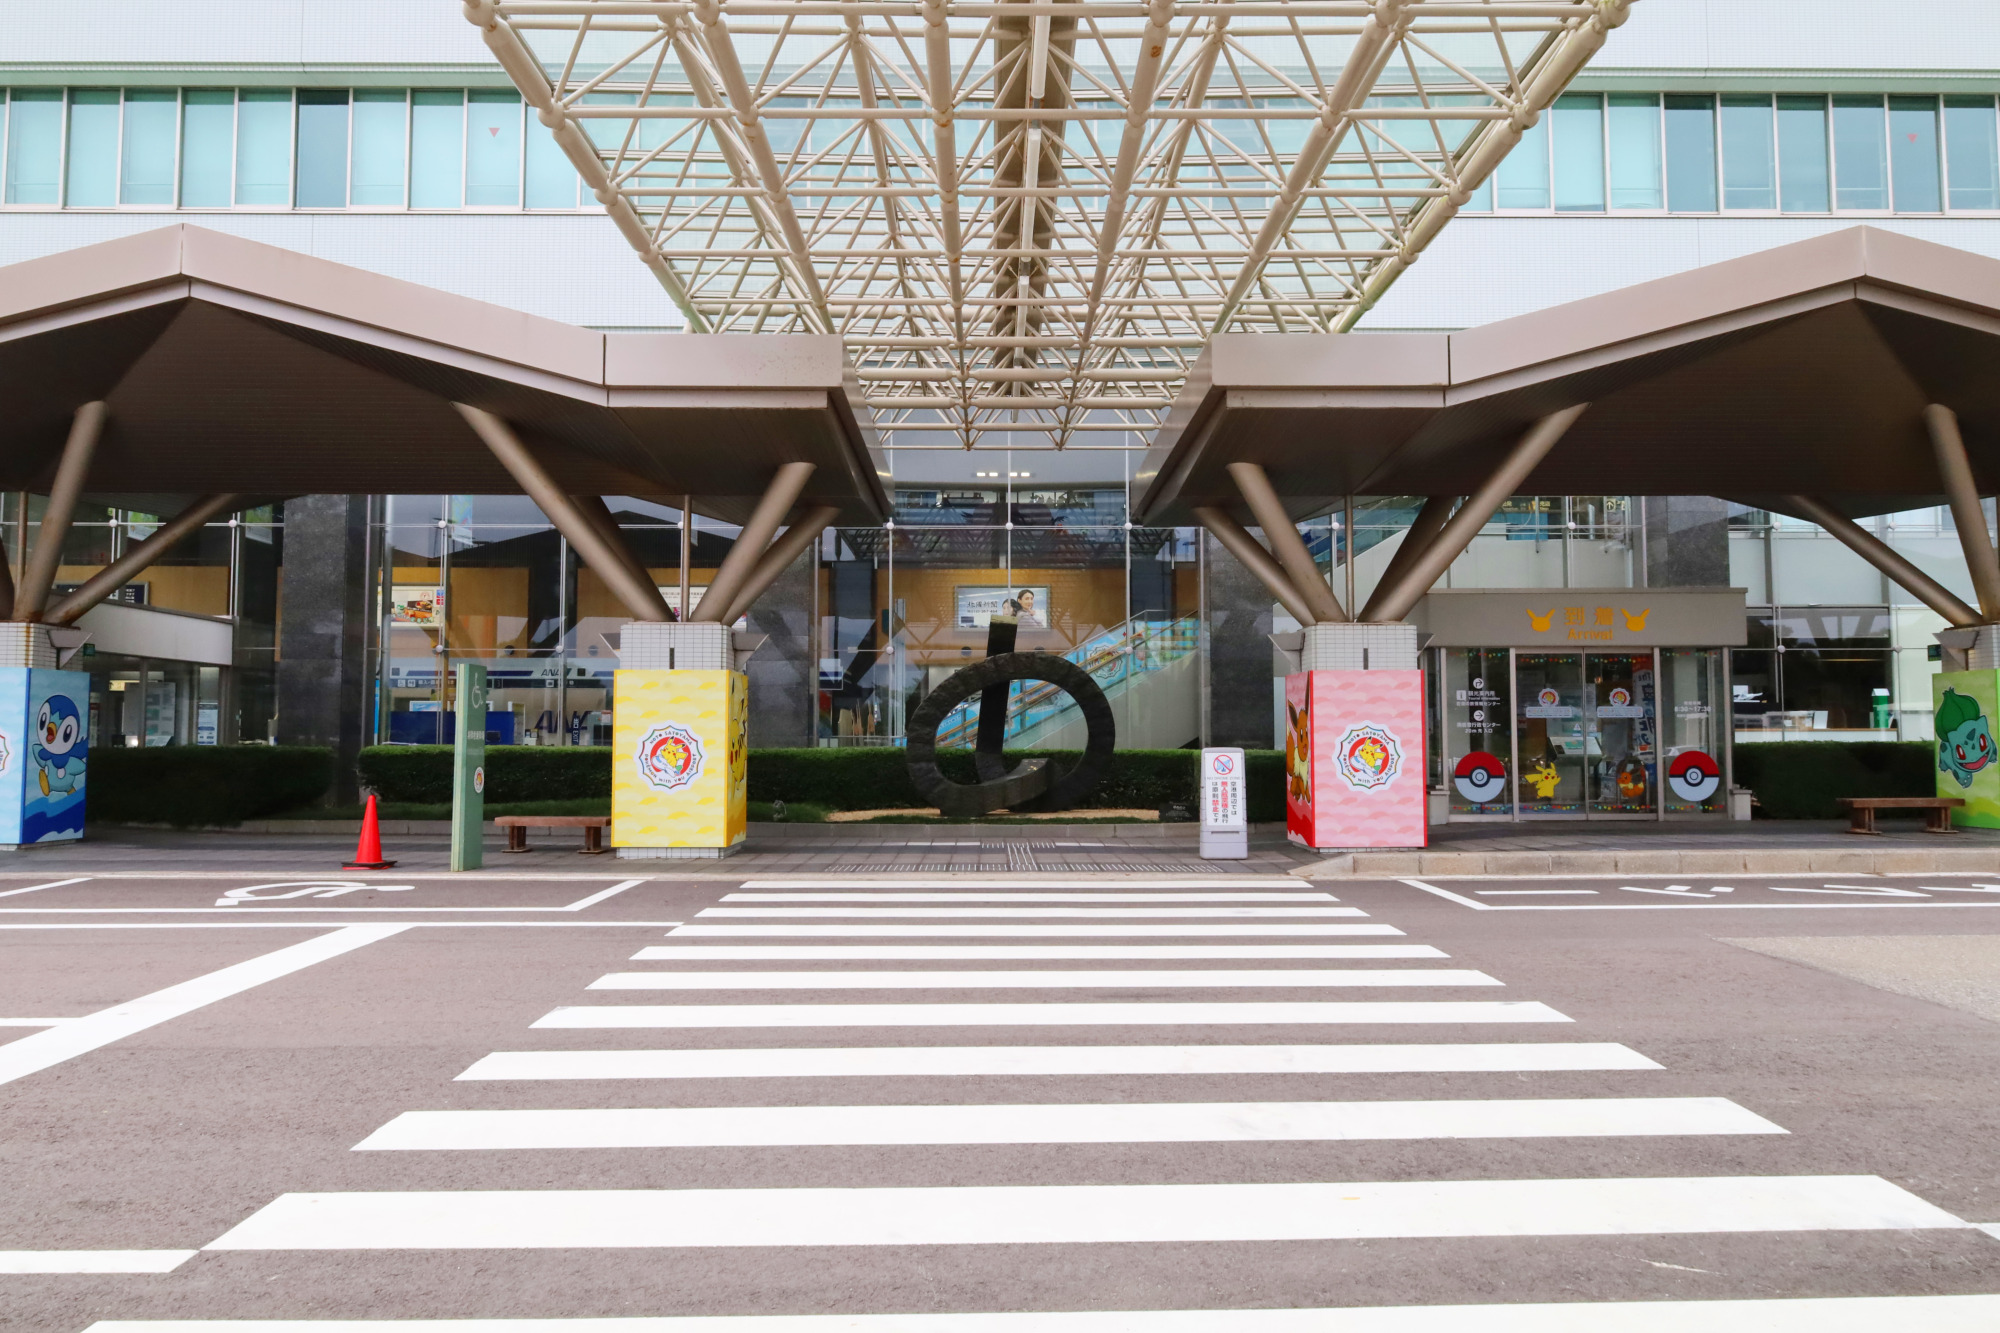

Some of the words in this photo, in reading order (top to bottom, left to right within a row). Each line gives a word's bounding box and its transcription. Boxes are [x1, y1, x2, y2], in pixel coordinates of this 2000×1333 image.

[1564, 606, 1614, 626] 到着
[1568, 628, 1613, 640] Arrival
[650, 733, 663, 744] NOTO
[664, 731, 692, 745] SATOYAMA
[1347, 733, 1360, 744] NOTO
[1361, 731, 1390, 745] SATOYAMA
[674, 775, 685, 783] YOU
[686, 753, 697, 776] AIRPORT
[1373, 775, 1384, 783] YOU
[1384, 753, 1395, 776] AIRPORT
